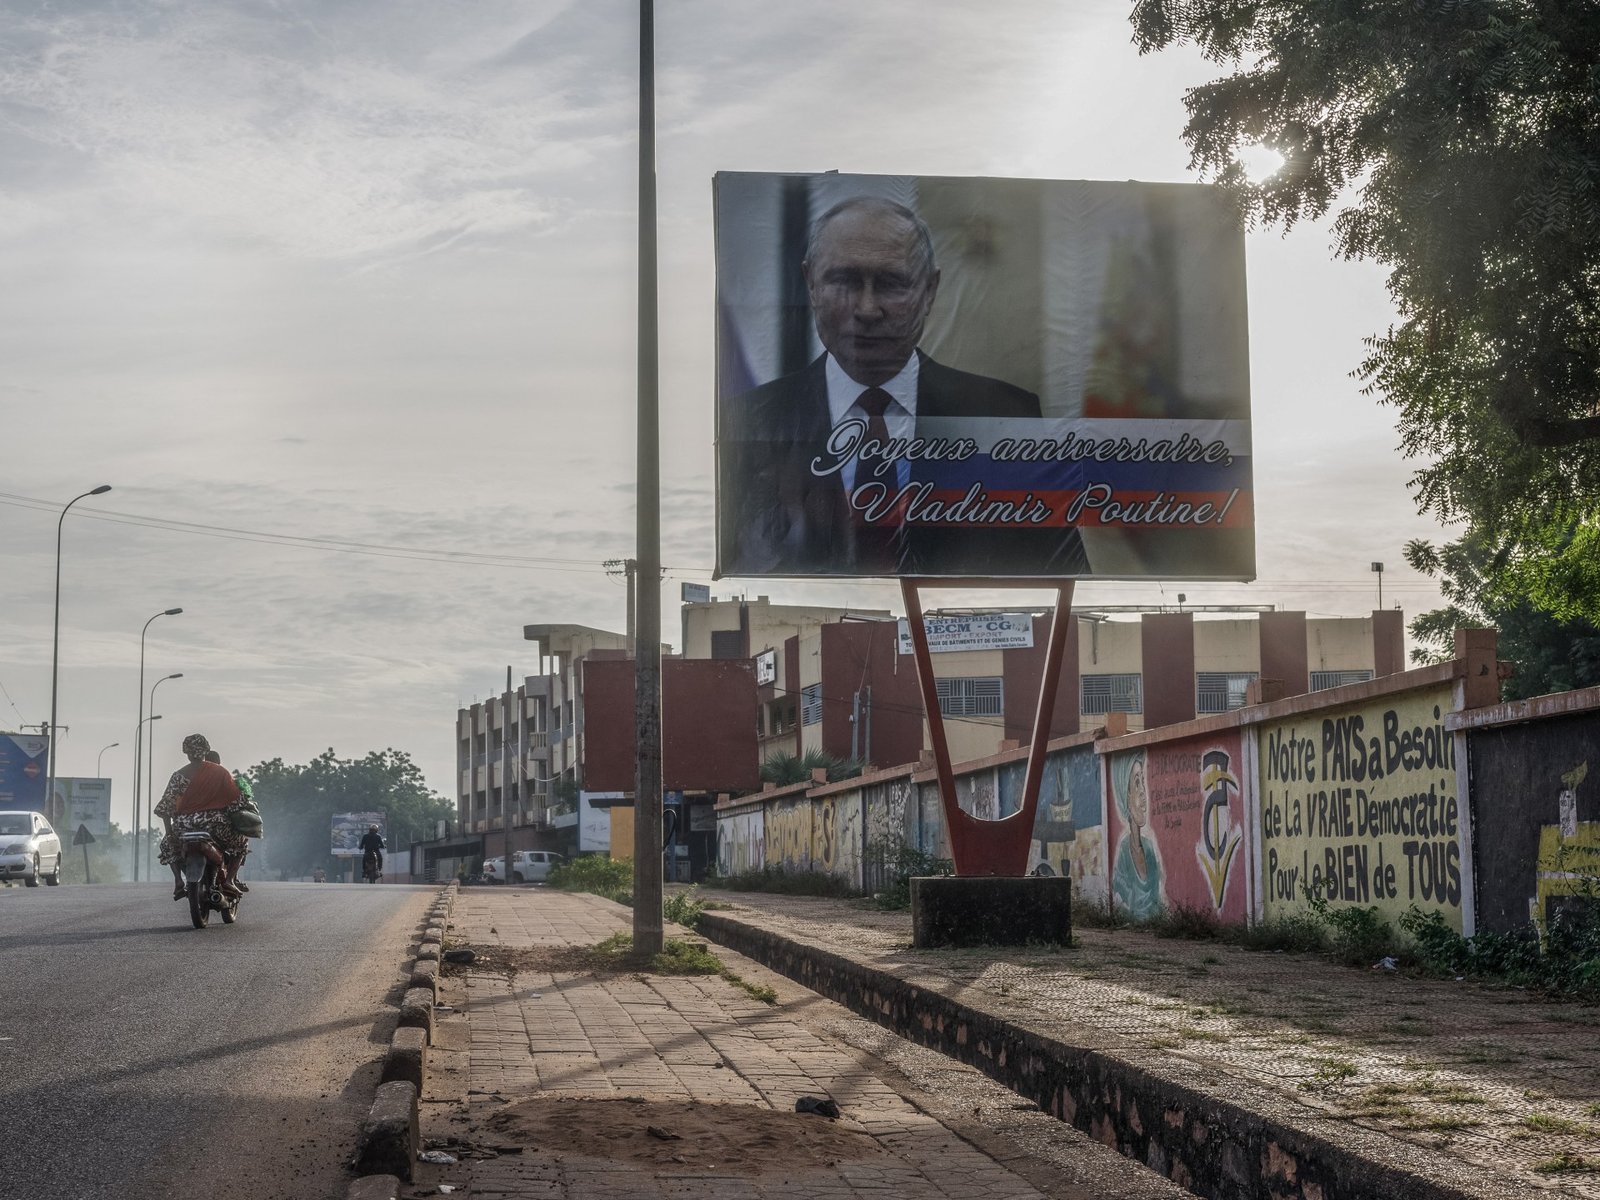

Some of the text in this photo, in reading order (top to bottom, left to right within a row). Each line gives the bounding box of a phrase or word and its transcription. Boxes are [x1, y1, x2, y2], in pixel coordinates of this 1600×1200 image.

[810, 418, 1235, 477] Joyeux anniversaire,
[850, 482, 1239, 524] Vladimir Poutine!
[986, 620, 1012, 631] CG
[1267, 704, 1456, 783] Notre PAYS a Besoin
[1264, 790, 1282, 839] de
[1306, 787, 1354, 838] VRAIE
[1355, 778, 1459, 839] Démocratie
[1268, 847, 1299, 902] Pour
[1324, 844, 1370, 903] BIEN
[1373, 841, 1398, 900] de
[1402, 840, 1462, 907] TOUS
